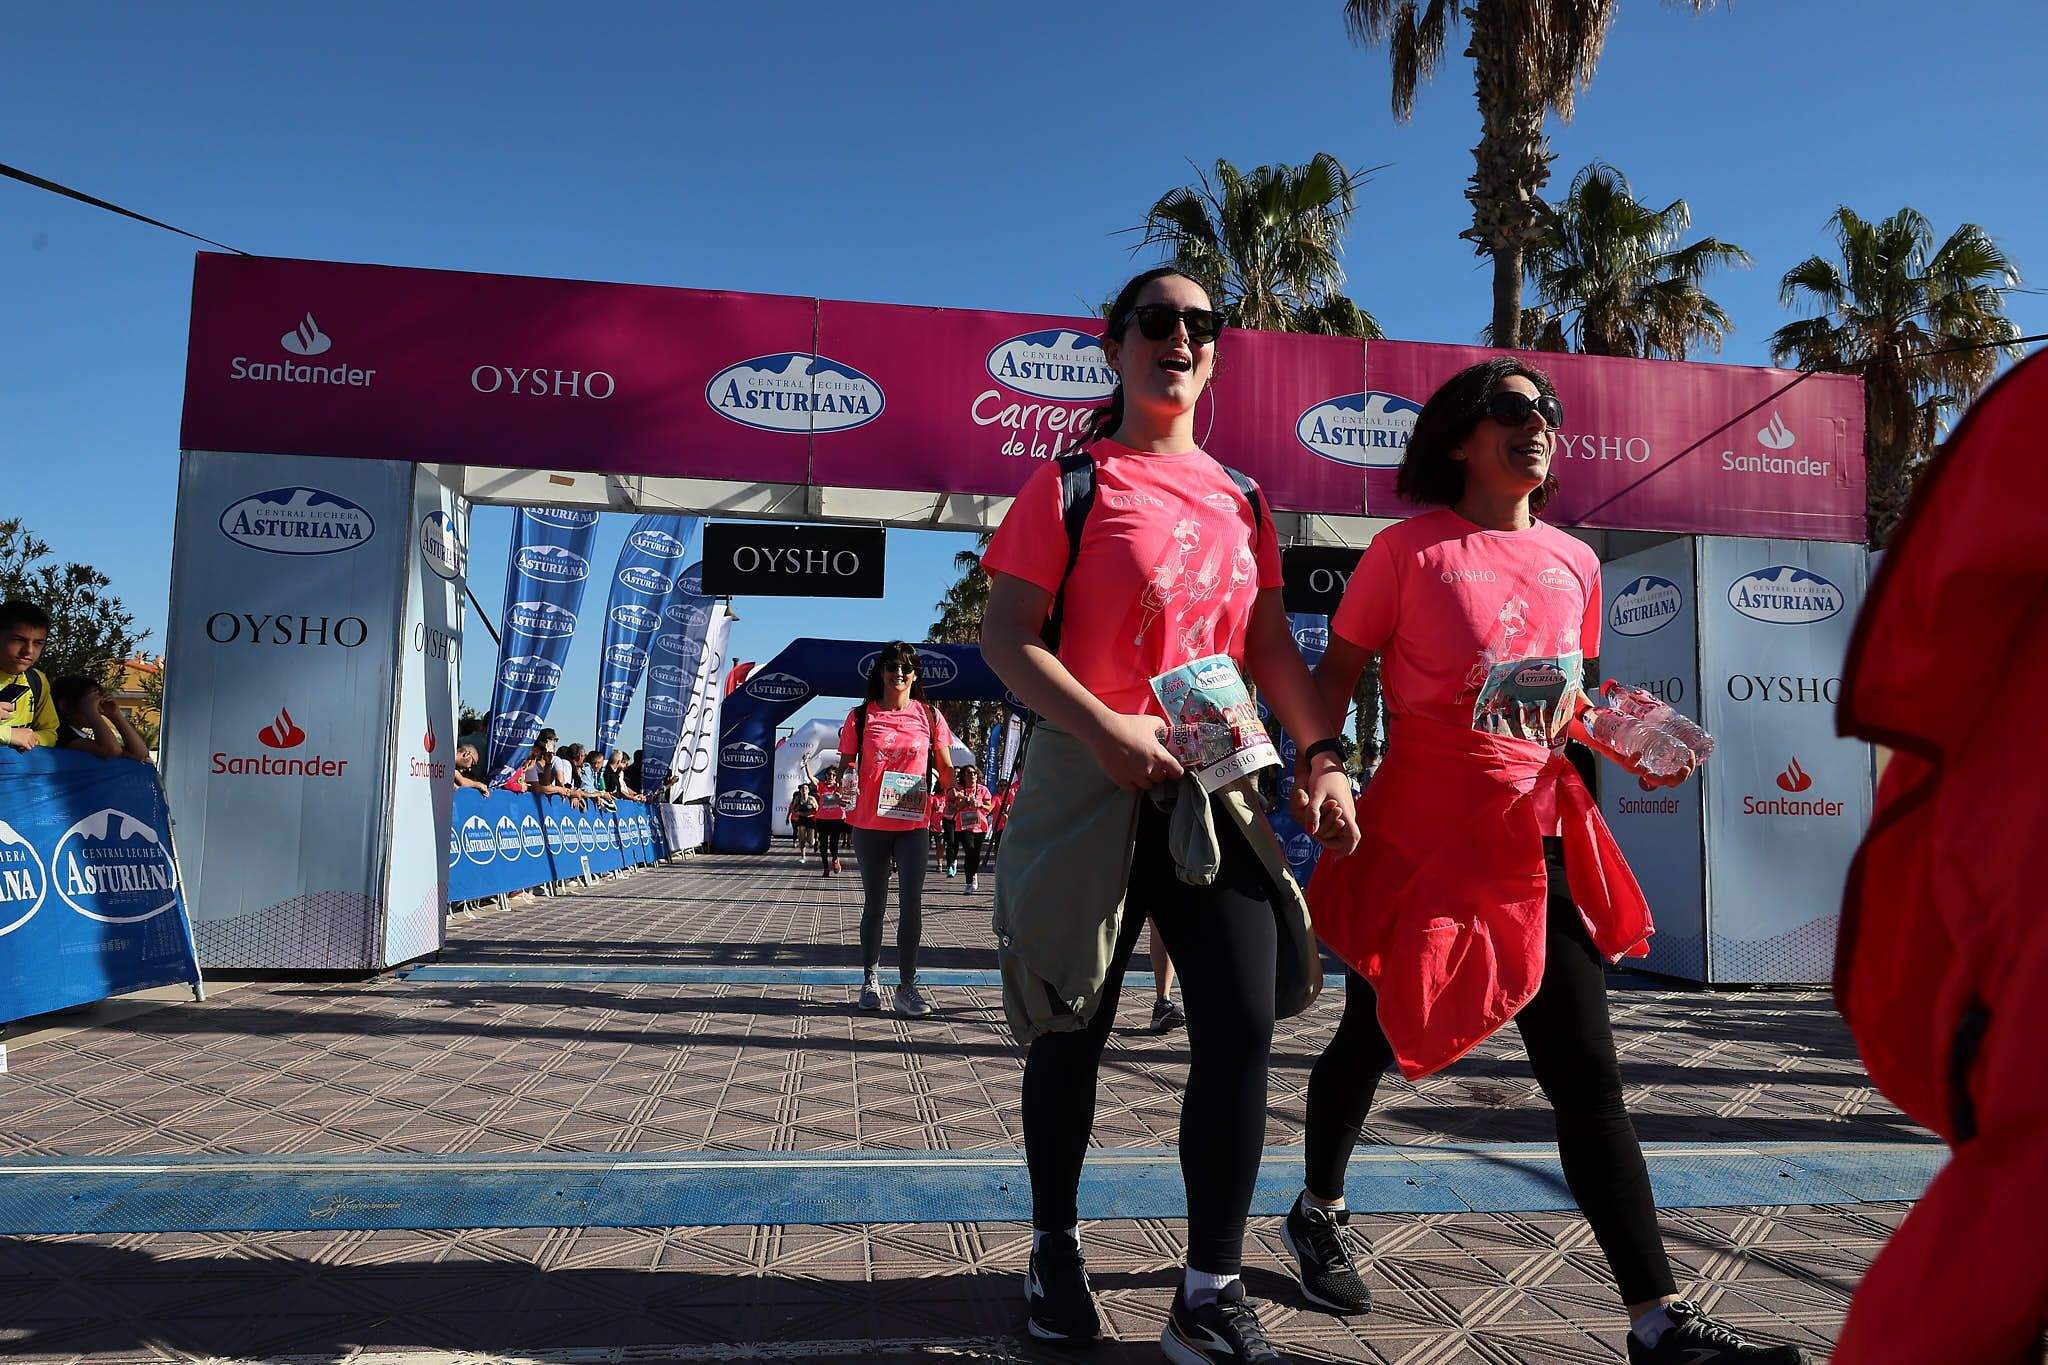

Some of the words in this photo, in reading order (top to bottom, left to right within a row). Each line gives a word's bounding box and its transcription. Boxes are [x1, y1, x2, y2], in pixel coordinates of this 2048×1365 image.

[1022, 350, 1070, 361] CENTRAL
[1076, 354, 1106, 363] LECH
[230, 356, 376, 386] Santander
[471, 365, 615, 399] OYSHO
[748, 377, 804, 389] CENTRAL
[719, 378, 872, 415] ASTURIANA
[1308, 416, 1410, 449] ASTURIA
[1387, 418, 1416, 427] LECH
[1001, 431, 1026, 457] de
[1030, 432, 1047, 459] la
[1553, 434, 1650, 463] YSHO
[1721, 451, 1831, 477] Santander
[230, 509, 364, 540] ASTURIANA
[256, 509, 306, 518] CENTRAL
[310, 511, 359, 520] LECHERA
[518, 553, 584, 577] ASTURIANA
[733, 546, 860, 576] OYSHO
[1440, 570, 1496, 584] OYSHO
[1736, 585, 1836, 611] ASTURIANA
[509, 608, 574, 633] ASTURIANA
[1613, 598, 1676, 627] ASTURIANA
[206, 612, 368, 647] OYSHO
[415, 622, 457, 664] OYSHO
[750, 682, 804, 695] ASTURIANA
[211, 752, 348, 777] Santander
[410, 757, 446, 779] Santander
[722, 751, 764, 763] ASTURIANA
[1215, 753, 1256, 778] OYSHO
[719, 800, 761, 811] ASTURIANA
[1618, 796, 1681, 815] Santander
[1743, 796, 1844, 817] Santander
[82, 848, 124, 859] CENTRAL
